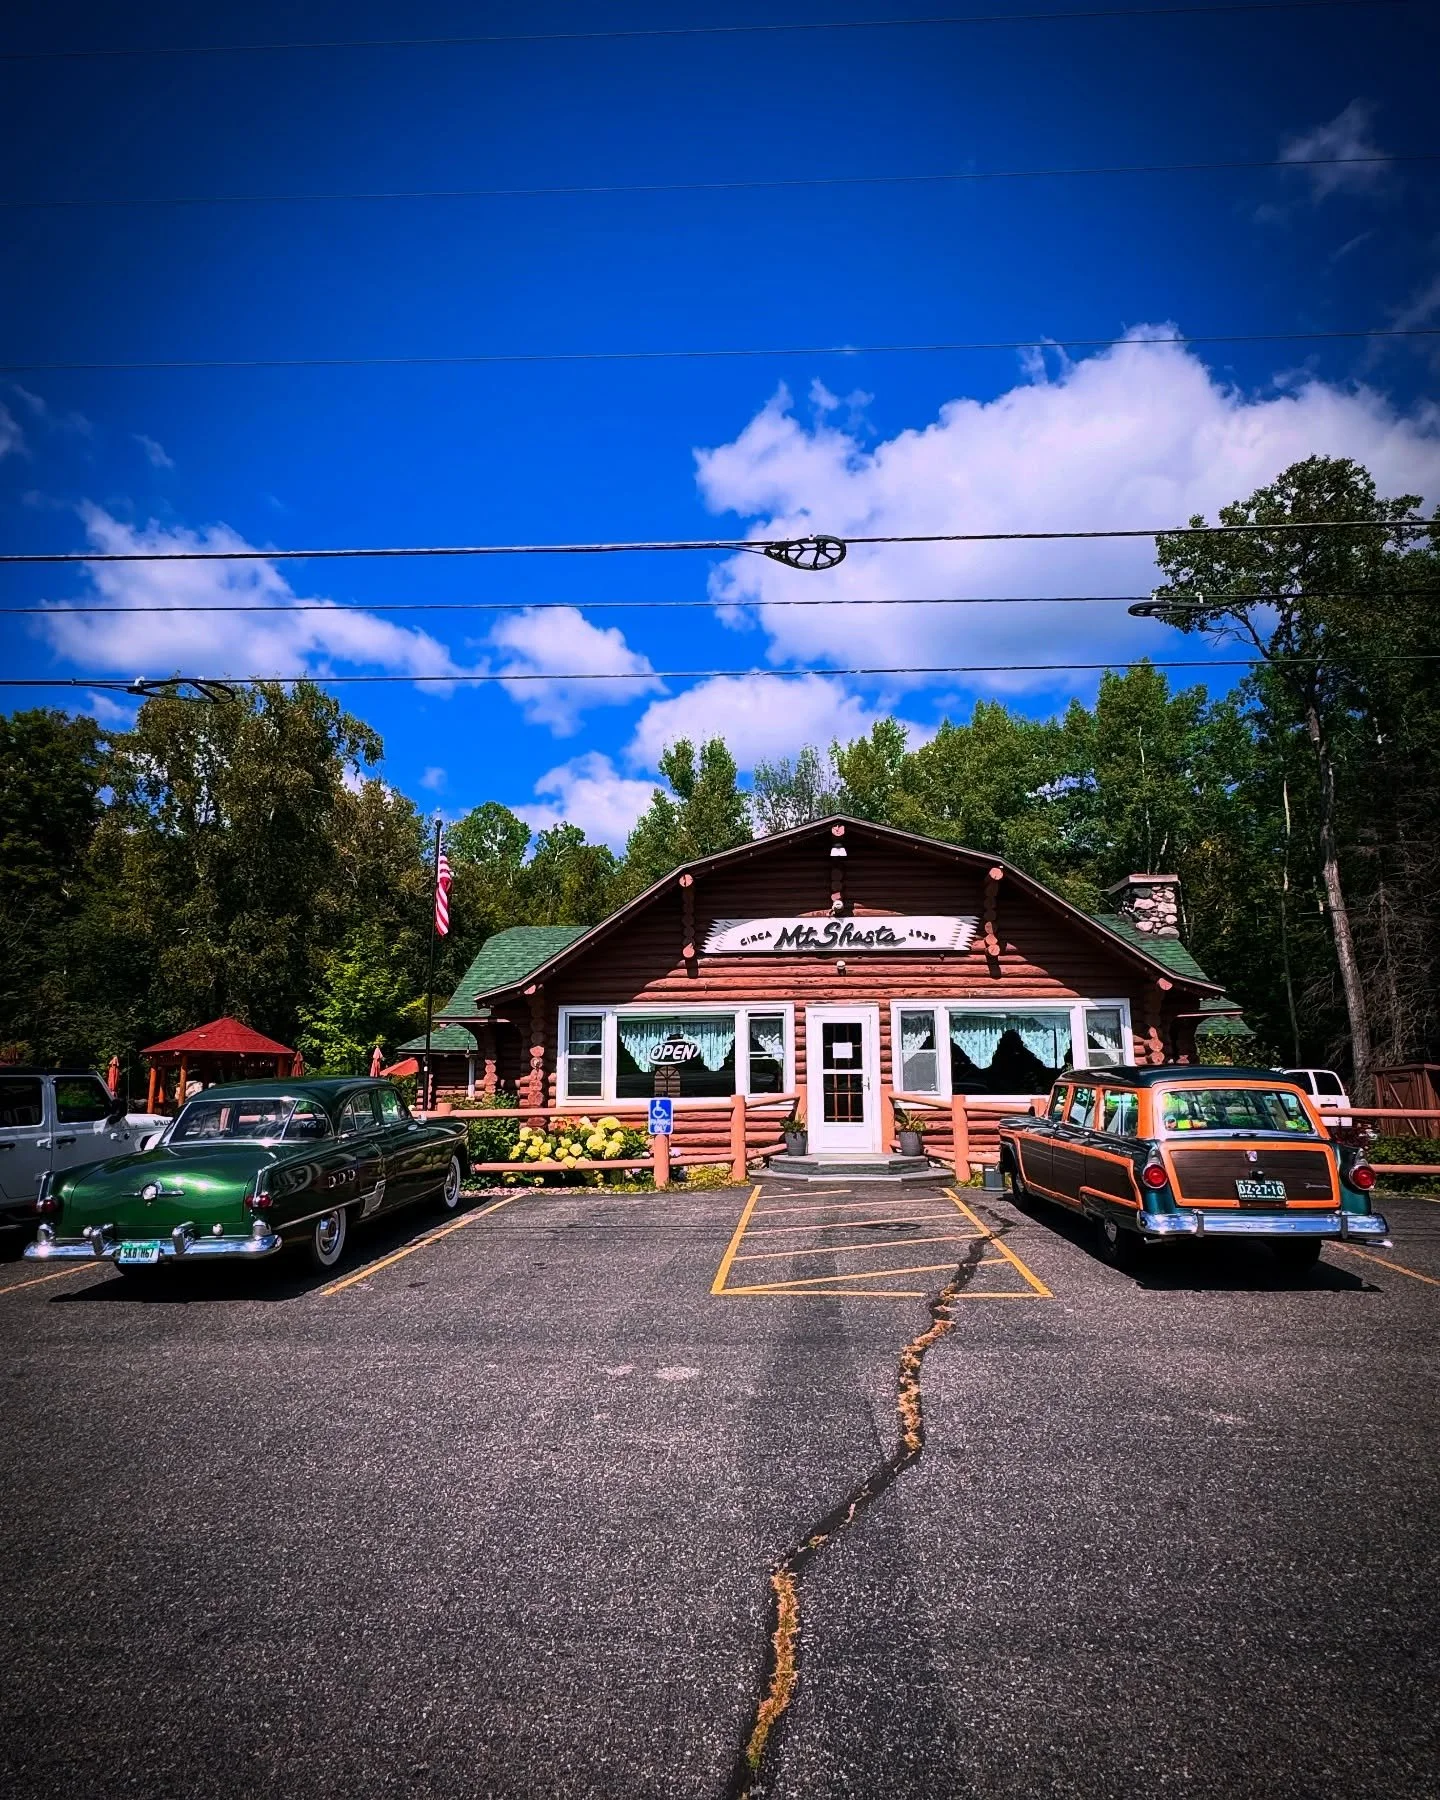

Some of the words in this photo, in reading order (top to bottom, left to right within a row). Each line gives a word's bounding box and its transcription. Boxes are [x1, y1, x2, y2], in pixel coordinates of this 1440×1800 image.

[740, 930, 773, 946] CIRCA
[817, 921, 907, 948] Shasta
[650, 1044, 695, 1060] OPEN
